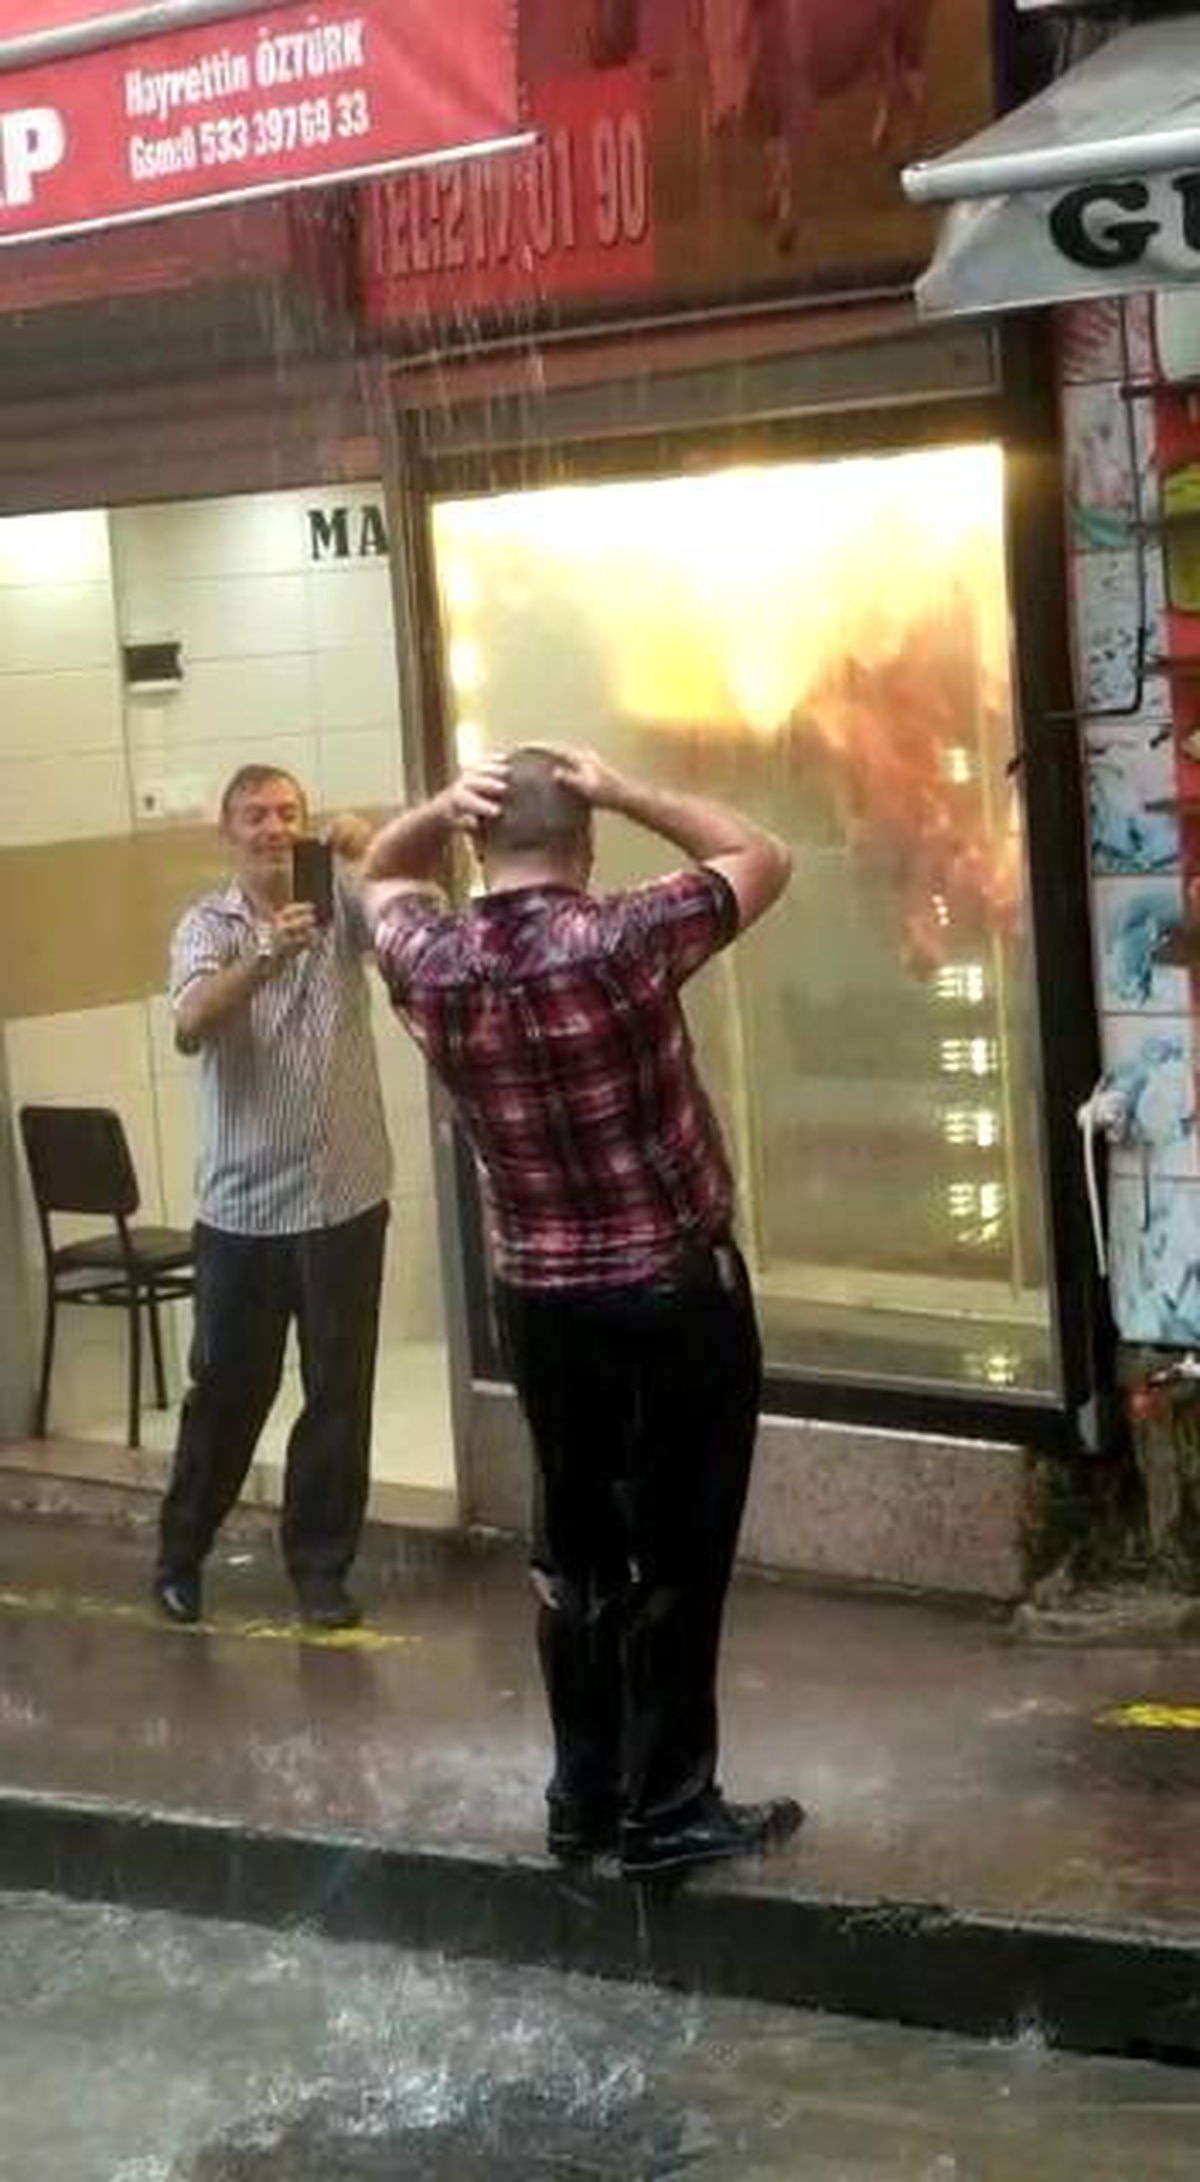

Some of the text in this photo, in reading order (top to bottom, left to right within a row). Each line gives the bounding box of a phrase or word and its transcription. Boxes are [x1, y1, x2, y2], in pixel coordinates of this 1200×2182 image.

[126, 15, 365, 121] Hayrettin ÖZTÜRK
[201, 115, 249, 165] 533
[336, 89, 369, 138] 33
[594, 112, 648, 246] 90
